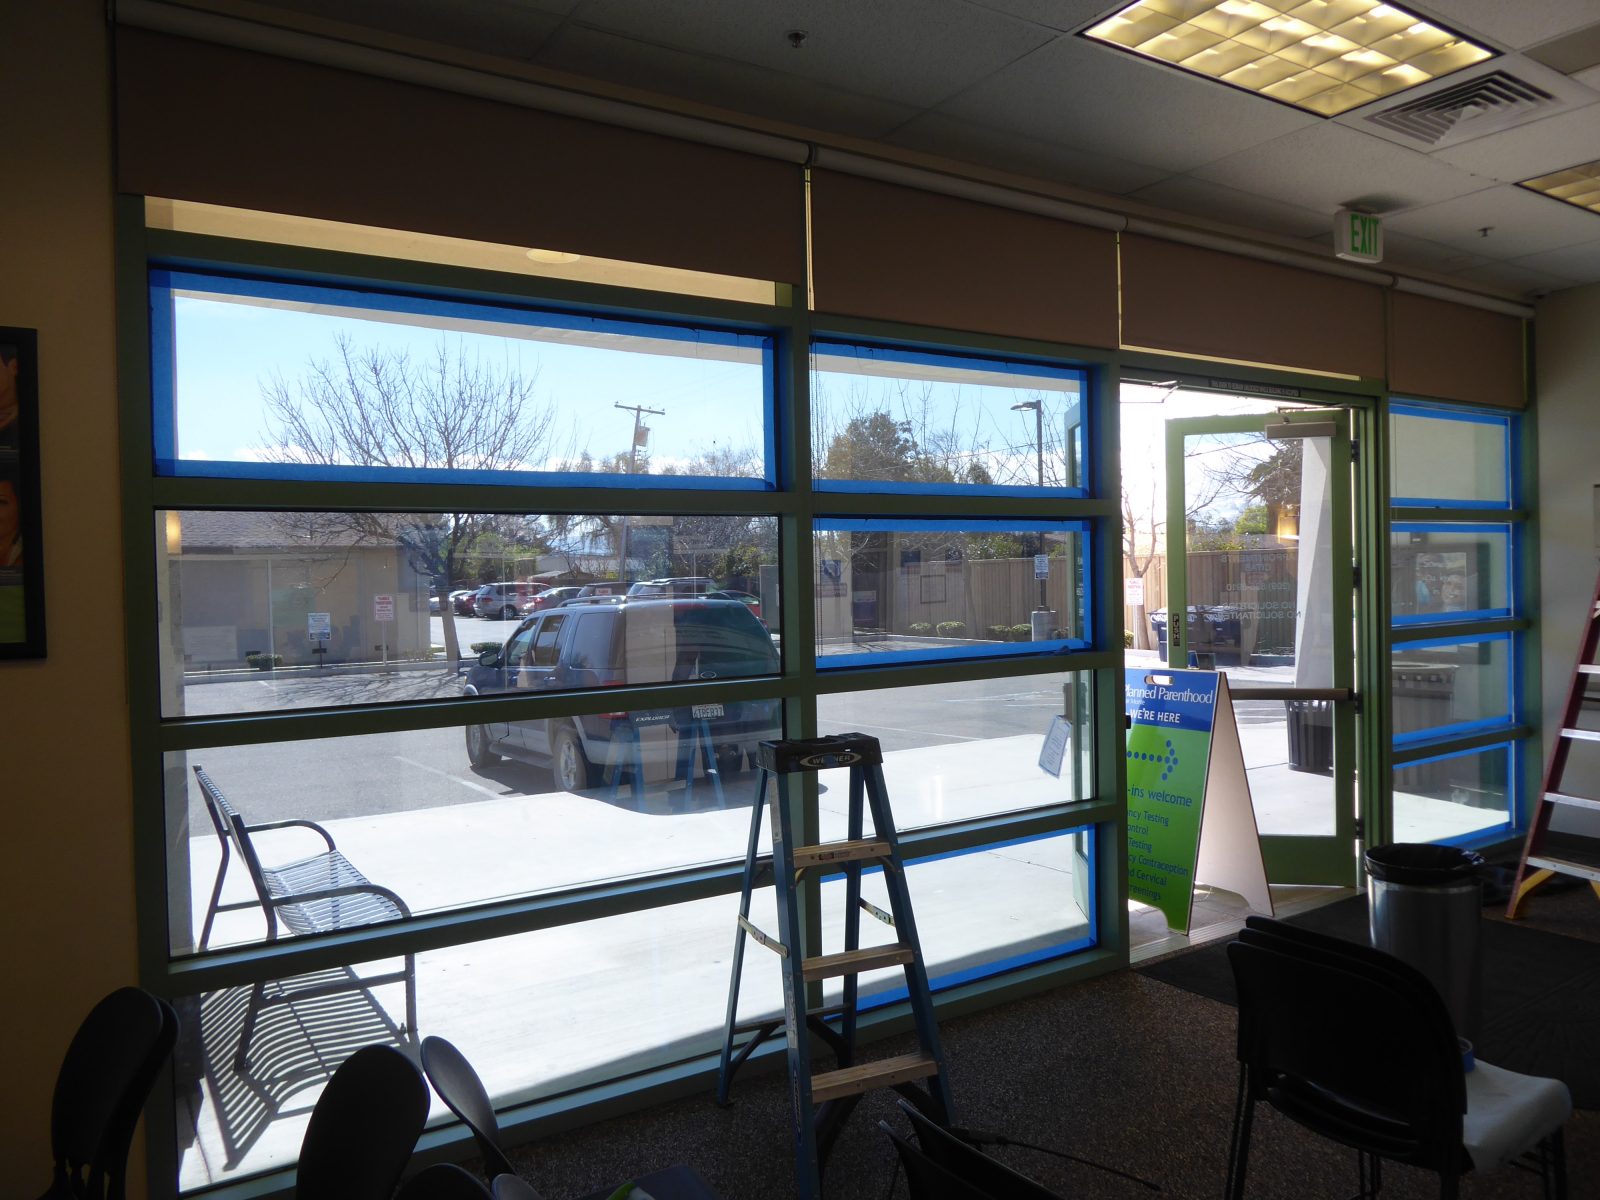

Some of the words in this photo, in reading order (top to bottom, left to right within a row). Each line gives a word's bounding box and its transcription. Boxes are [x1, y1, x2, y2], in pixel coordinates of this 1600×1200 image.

[1351, 214, 1379, 256] EXIT
[1158, 687, 1214, 704] Parenthood
[1130, 708, 1155, 720] WE'RE
[1157, 712, 1181, 723] HERE
[1148, 791, 1192, 807] welcome
[1144, 811, 1169, 827] Testing
[1128, 825, 1149, 835] ontrol
[1139, 855, 1188, 877] Contraception
[1136, 870, 1168, 886] Cervical
